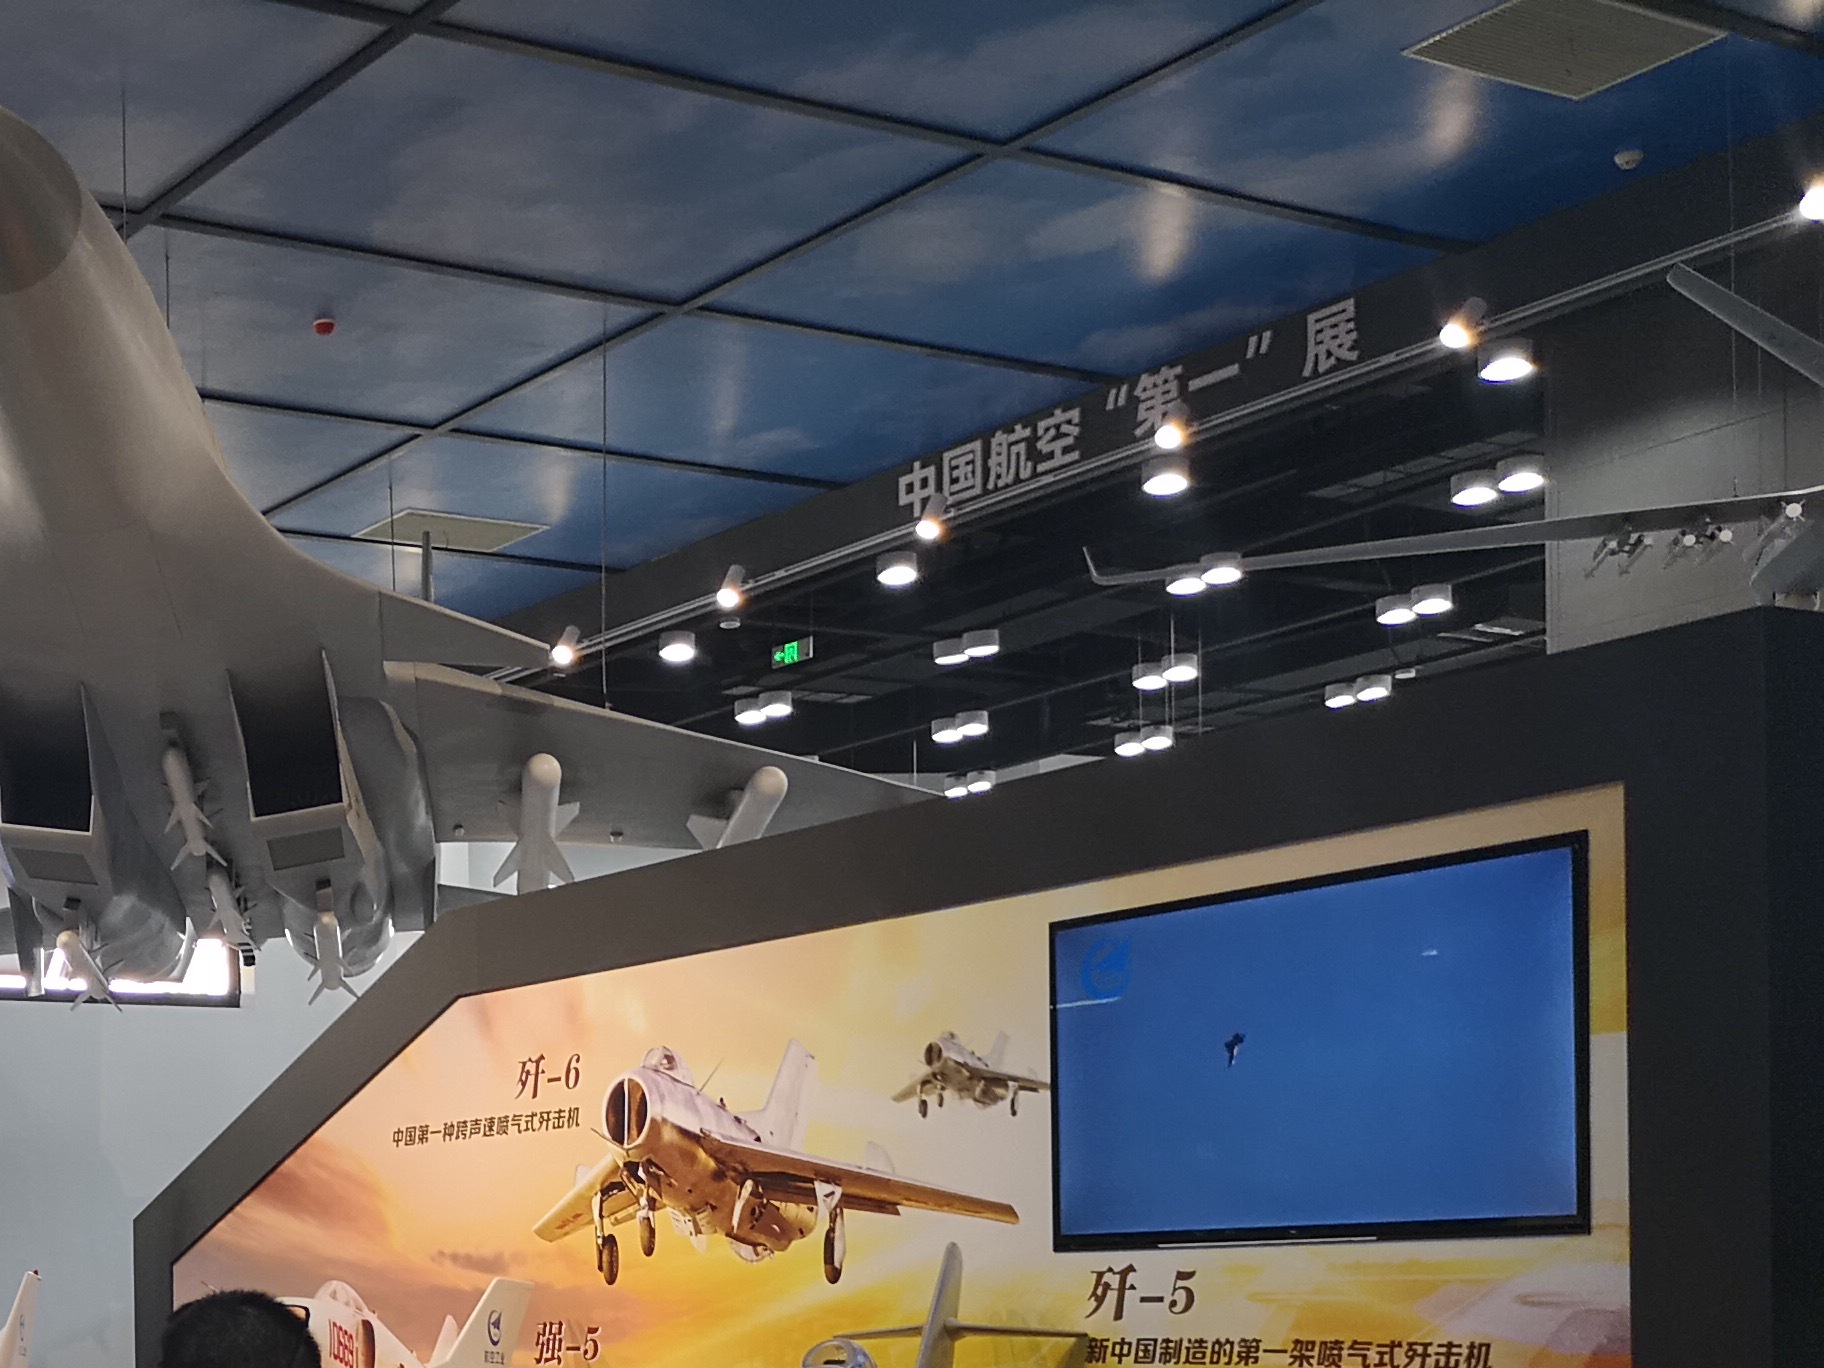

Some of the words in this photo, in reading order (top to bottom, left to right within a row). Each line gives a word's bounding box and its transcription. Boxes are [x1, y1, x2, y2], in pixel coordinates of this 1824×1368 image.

[515, 1053, 581, 1100] 歼-6
[392, 1106, 581, 1148] 中国第一种跨声速喷气式歼击机
[1085, 1263, 1197, 1322] 歼-5
[534, 1320, 602, 1366] 强-5
